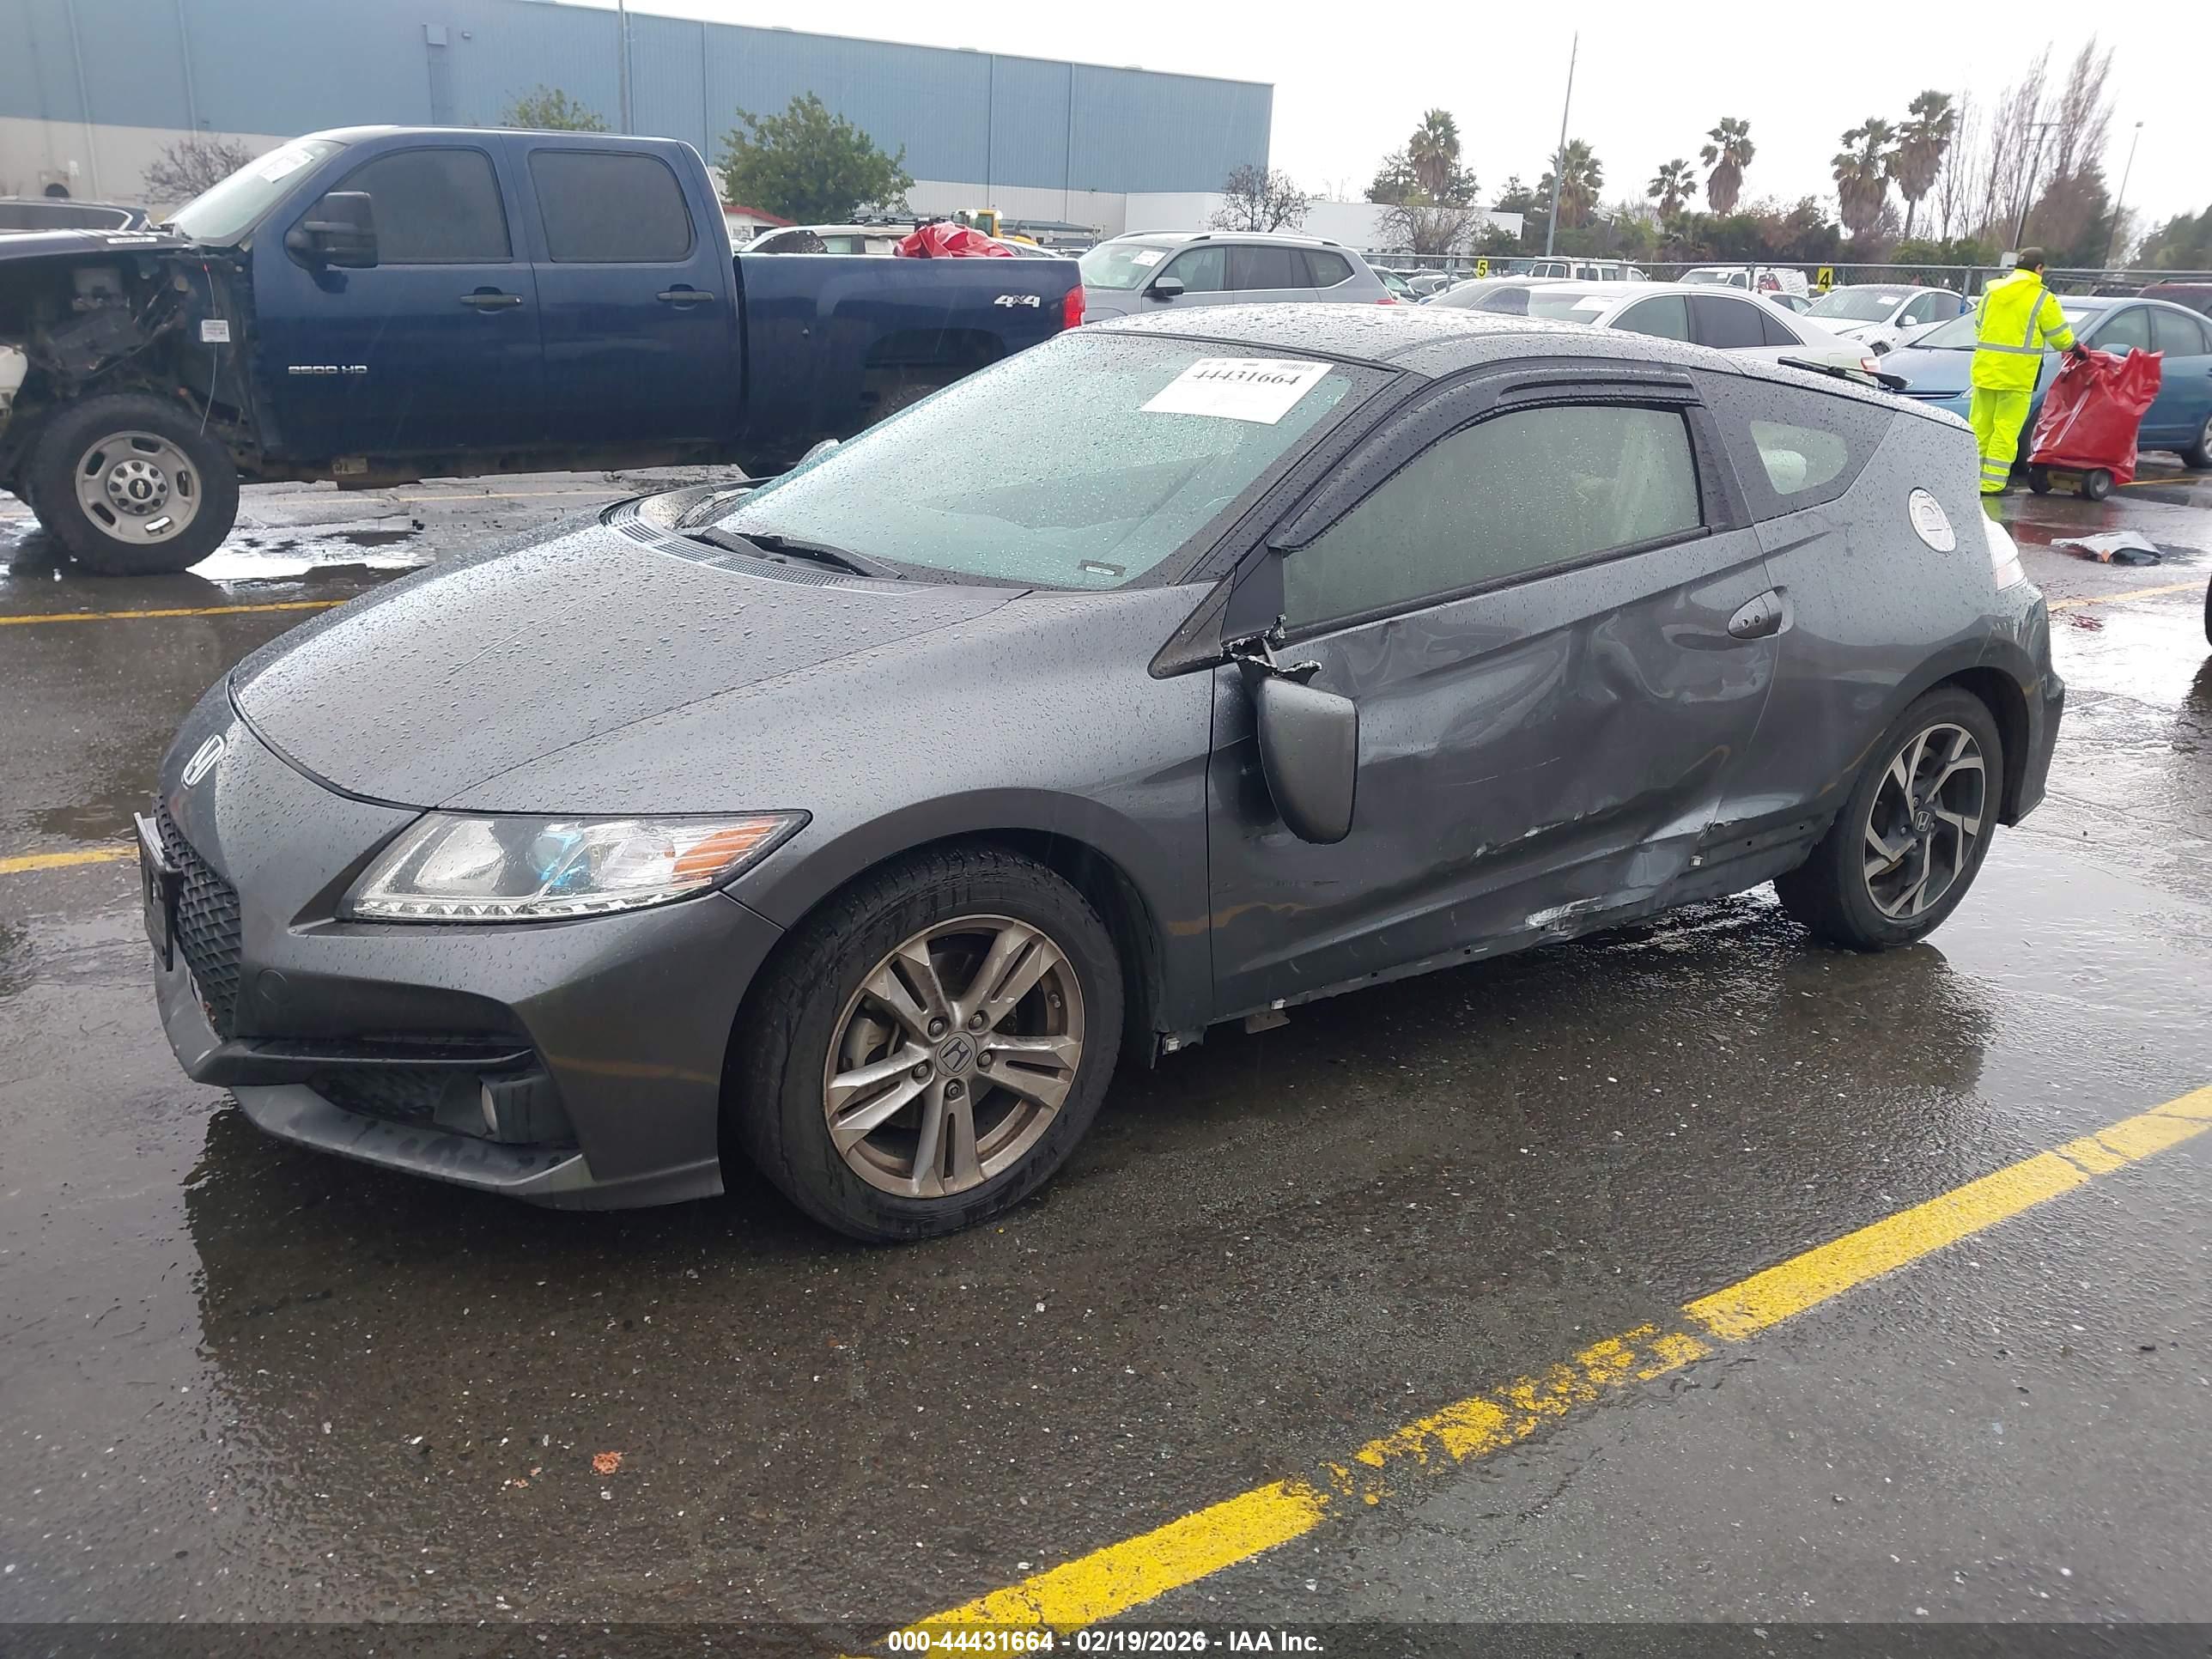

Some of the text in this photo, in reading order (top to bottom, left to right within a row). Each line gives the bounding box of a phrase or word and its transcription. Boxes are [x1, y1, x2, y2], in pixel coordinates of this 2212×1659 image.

[1479, 262, 1486, 276] 5
[1819, 270, 1831, 289] 4
[1193, 368, 1303, 386] 44431664
